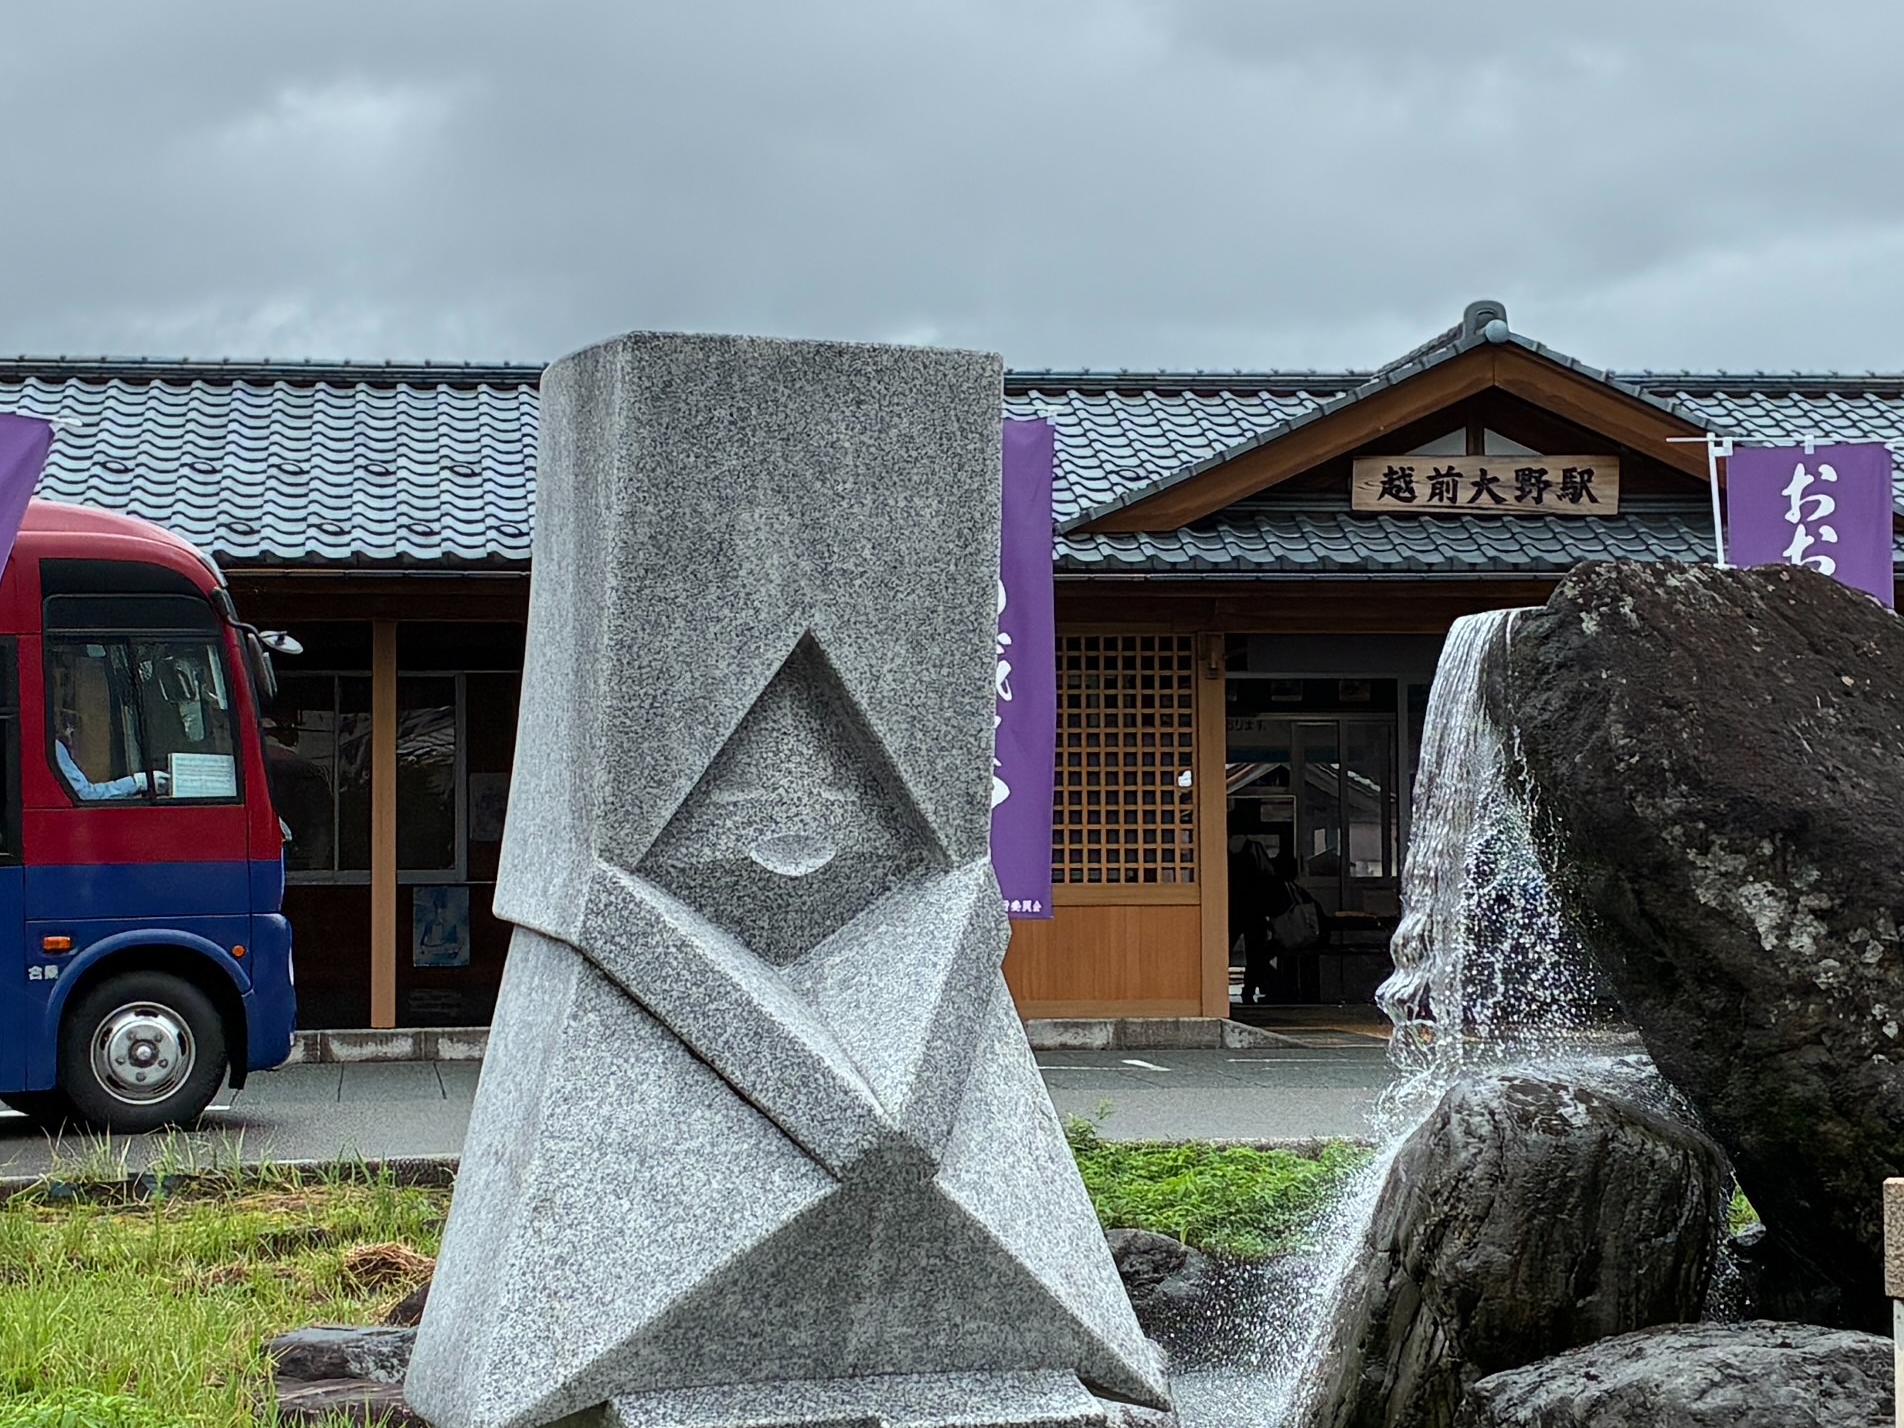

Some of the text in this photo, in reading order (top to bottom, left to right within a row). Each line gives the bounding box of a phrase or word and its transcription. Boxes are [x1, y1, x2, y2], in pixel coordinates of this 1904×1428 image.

[1377, 465, 1600, 505] 越前大野駅
